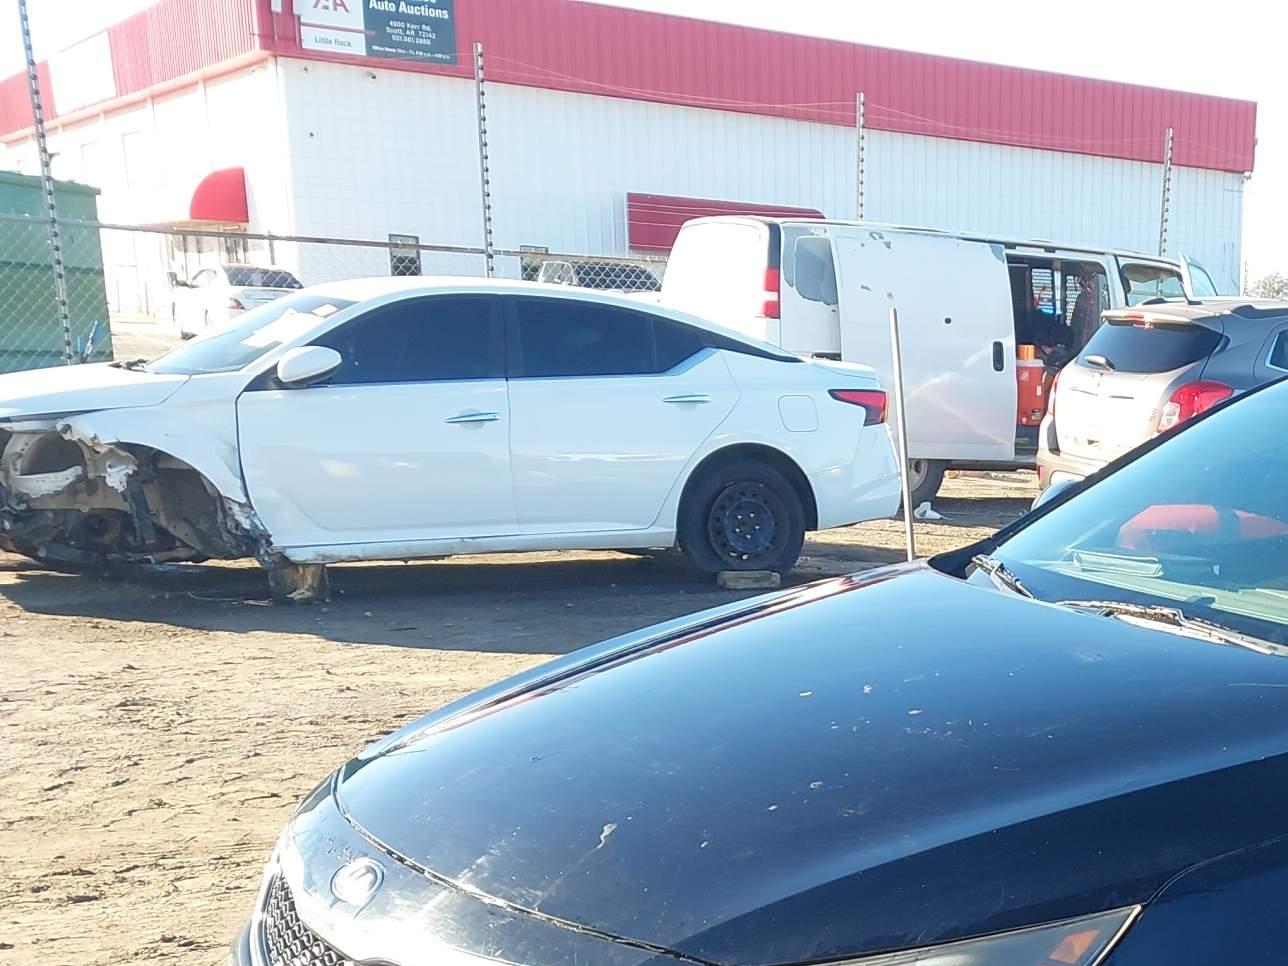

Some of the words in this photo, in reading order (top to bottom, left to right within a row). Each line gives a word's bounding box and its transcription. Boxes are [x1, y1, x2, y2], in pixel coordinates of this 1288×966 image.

[369, 0, 396, 12] Auto
[398, 1, 449, 19] Auctions
[314, 35, 333, 45] Little
[334, 38, 353, 47] Rock
